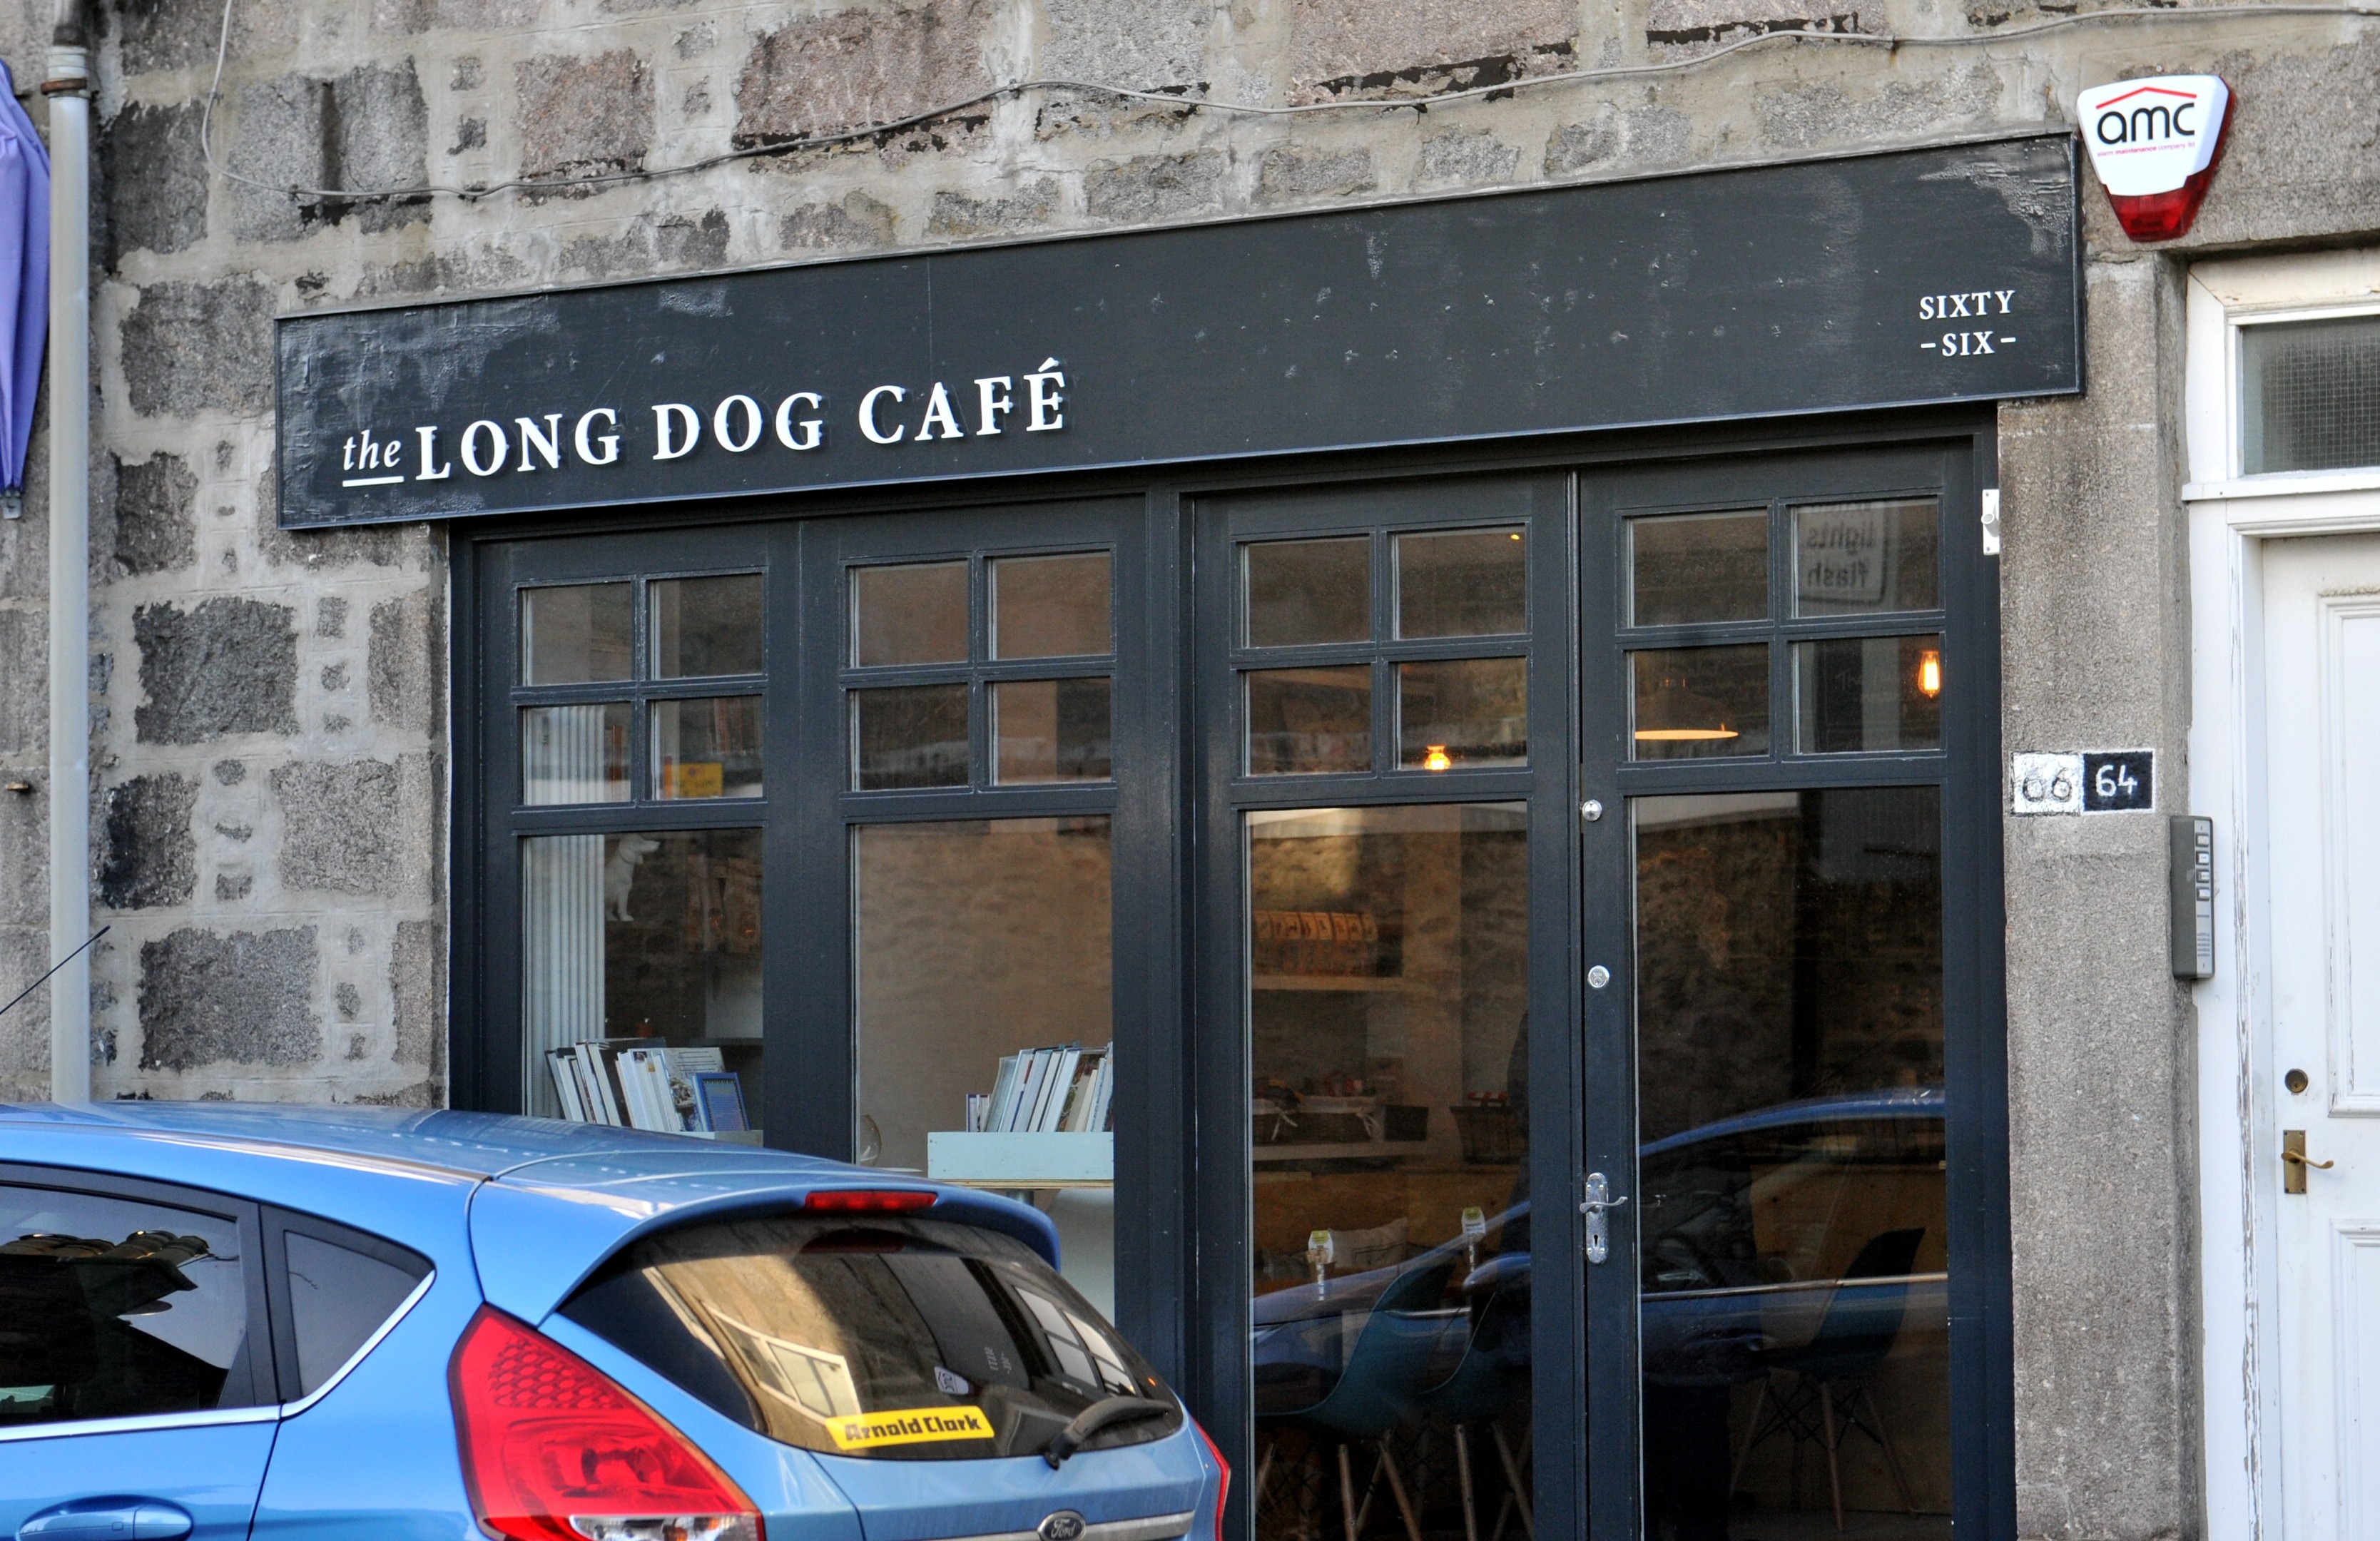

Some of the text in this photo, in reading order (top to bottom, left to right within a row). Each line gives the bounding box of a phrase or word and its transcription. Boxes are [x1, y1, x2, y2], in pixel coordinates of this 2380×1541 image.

[2097, 101, 2195, 145] amc
[2115, 146, 2157, 156] maintenance
[1919, 290, 2015, 320] SIXTY
[343, 357, 1066, 480] the LONG DOG CAFÉ
[2095, 764, 2138, 798] 64
[844, 1414, 982, 1441] Arnold Clark
[1051, 1517, 1077, 1539] Ford
